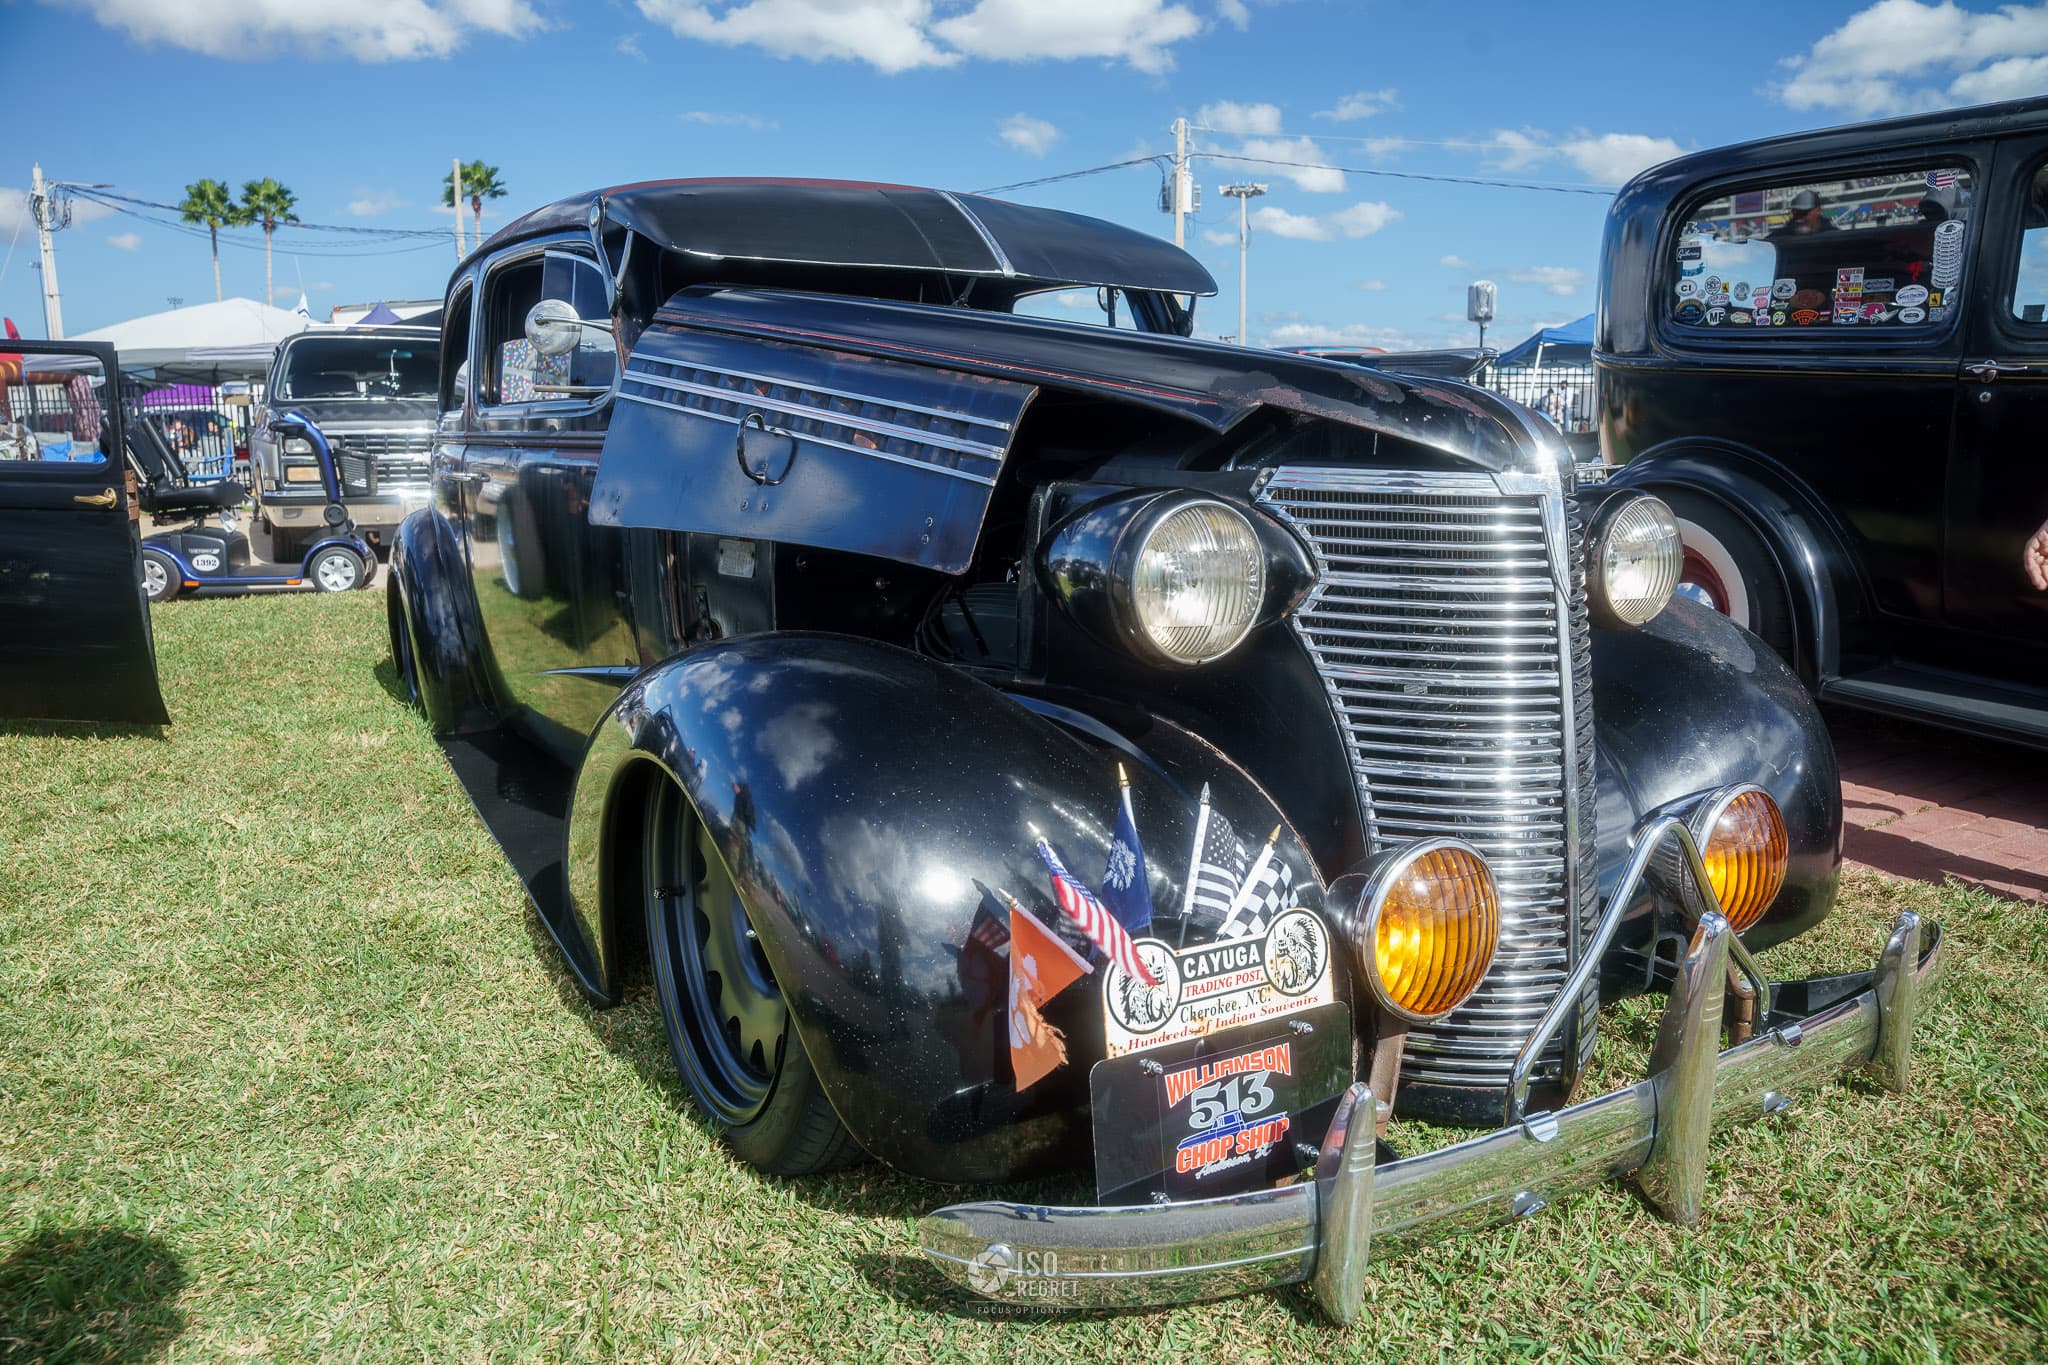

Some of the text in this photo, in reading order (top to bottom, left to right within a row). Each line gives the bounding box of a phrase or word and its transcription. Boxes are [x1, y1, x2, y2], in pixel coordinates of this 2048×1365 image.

[1183, 943, 1261, 979] CAYUGA
[1185, 969, 1262, 998] TRADING POST
[1128, 995, 1319, 1050] Hundreds of Indian Souvenirs
[1180, 986, 1272, 1024] Cherokee, N.C.
[1165, 1042, 1292, 1108] WILLIAMSON
[1188, 1070, 1275, 1129] 513
[1176, 1116, 1290, 1174] CHOP SHOP
